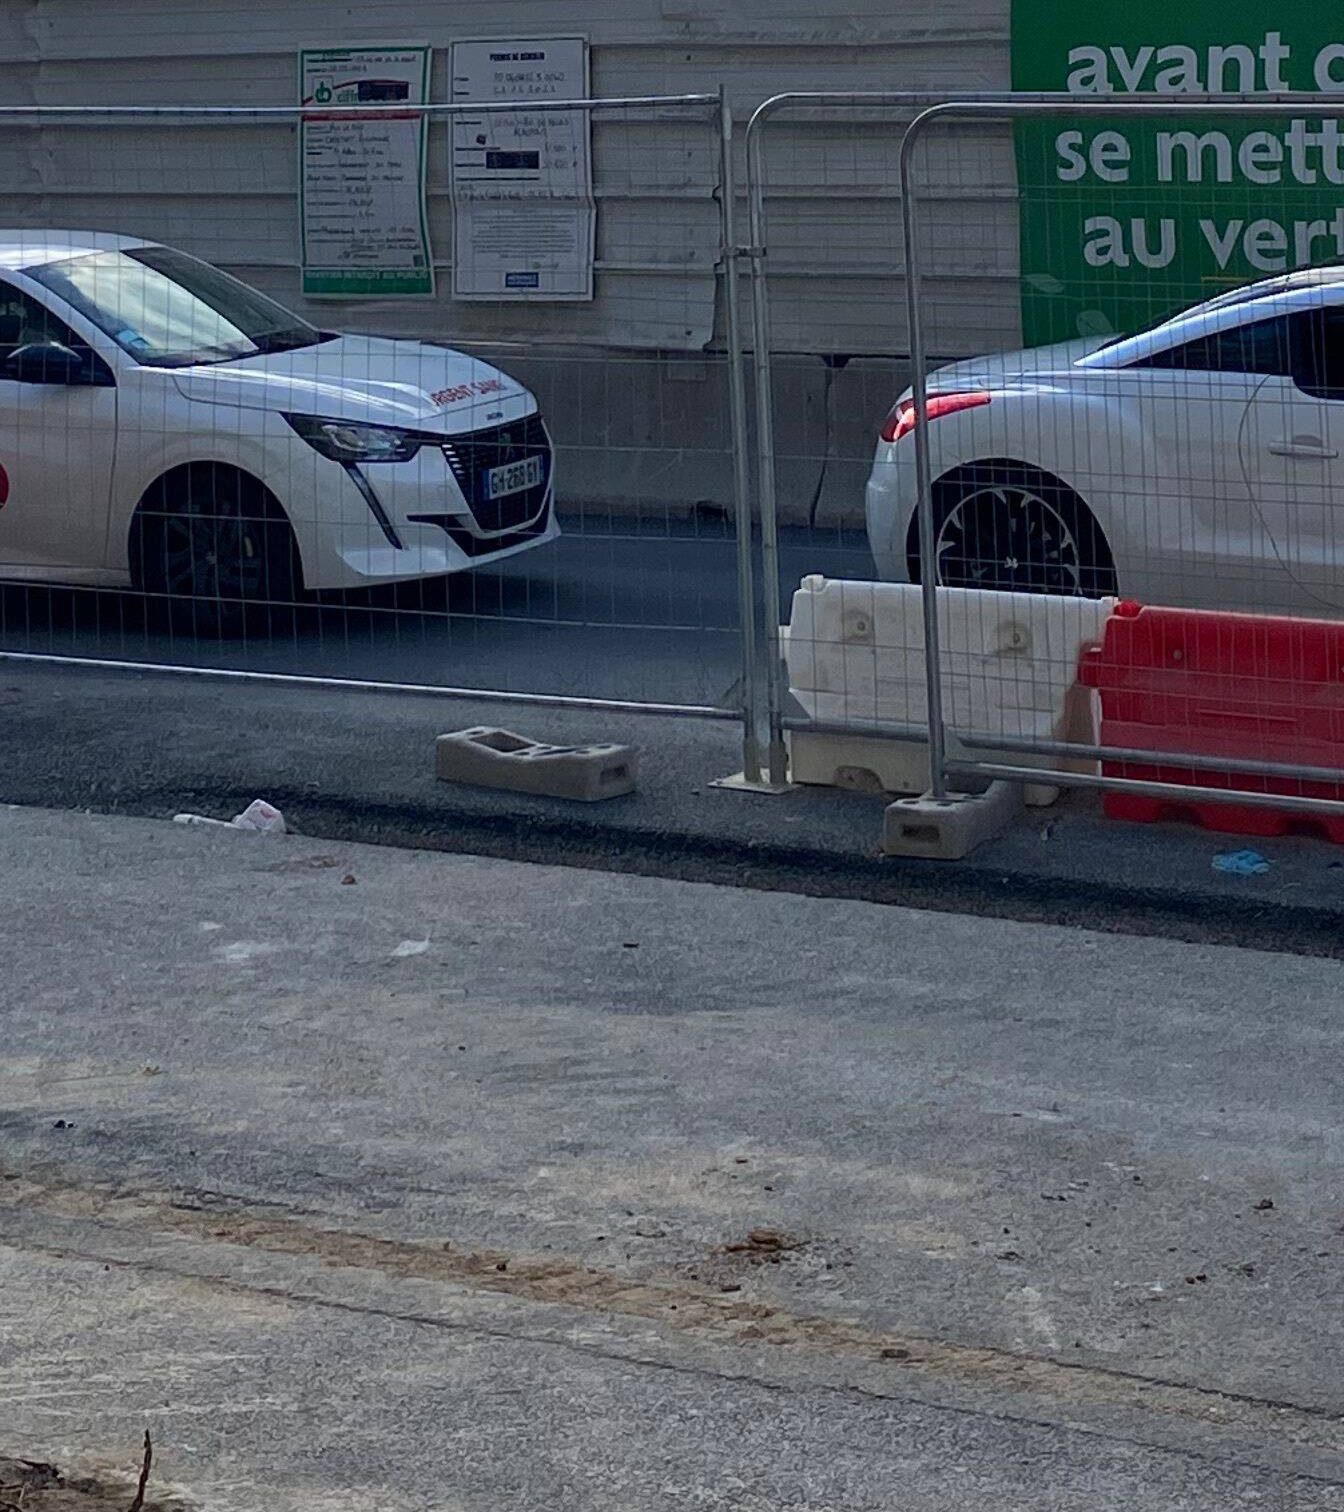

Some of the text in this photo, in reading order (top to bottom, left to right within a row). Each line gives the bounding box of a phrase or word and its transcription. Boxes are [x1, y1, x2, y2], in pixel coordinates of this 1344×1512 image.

[1067, 31, 1290, 92] avant
[1055, 130, 1130, 182] se
[1083, 216, 1175, 268] au
